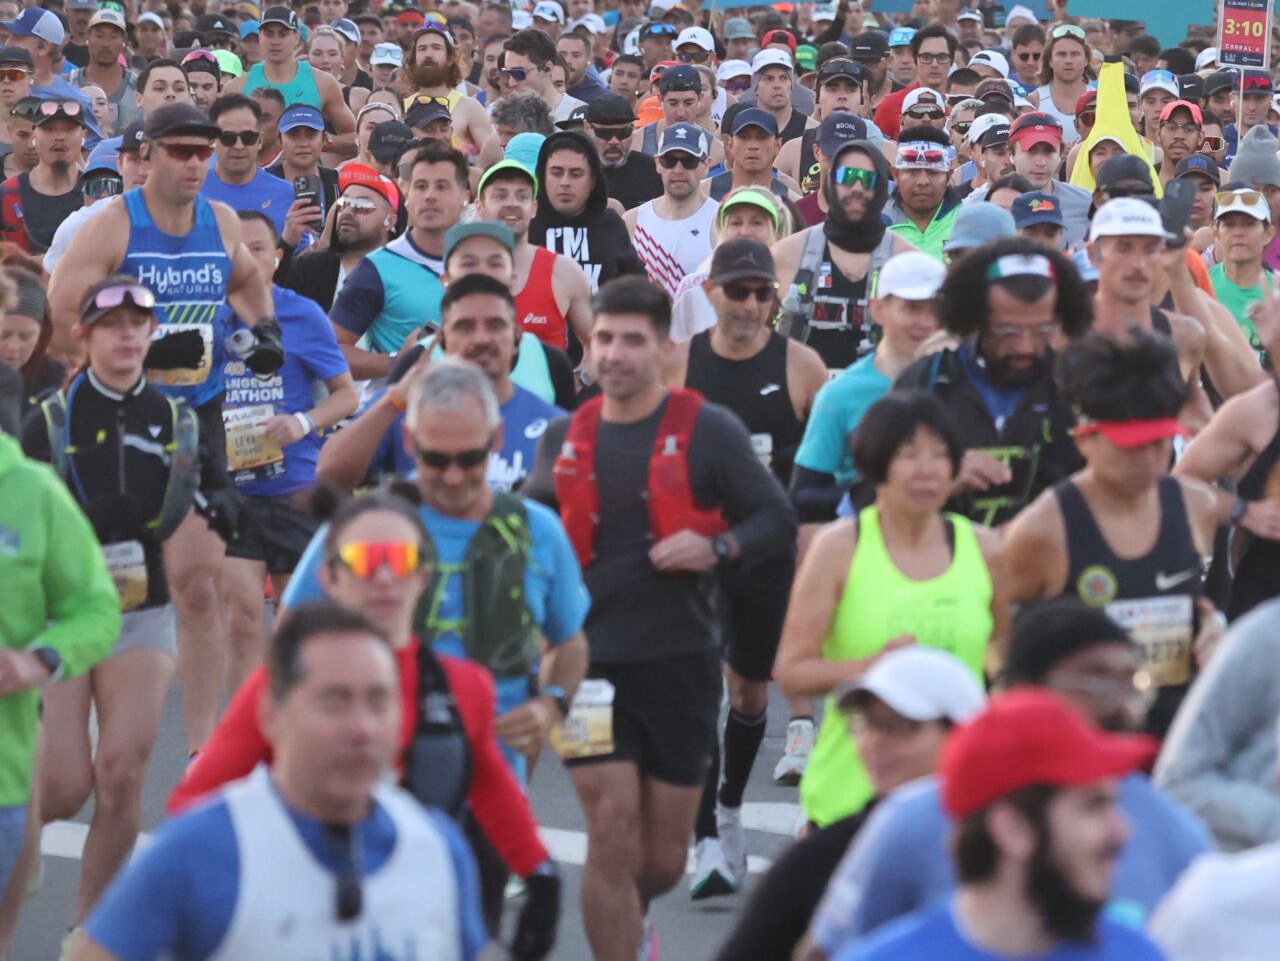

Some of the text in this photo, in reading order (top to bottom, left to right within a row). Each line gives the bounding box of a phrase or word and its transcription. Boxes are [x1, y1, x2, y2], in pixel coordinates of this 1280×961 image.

[1224, 18, 1264, 37] 3:10
[1224, 42, 1253, 52] CORRAL
[545, 226, 590, 262] I'M
